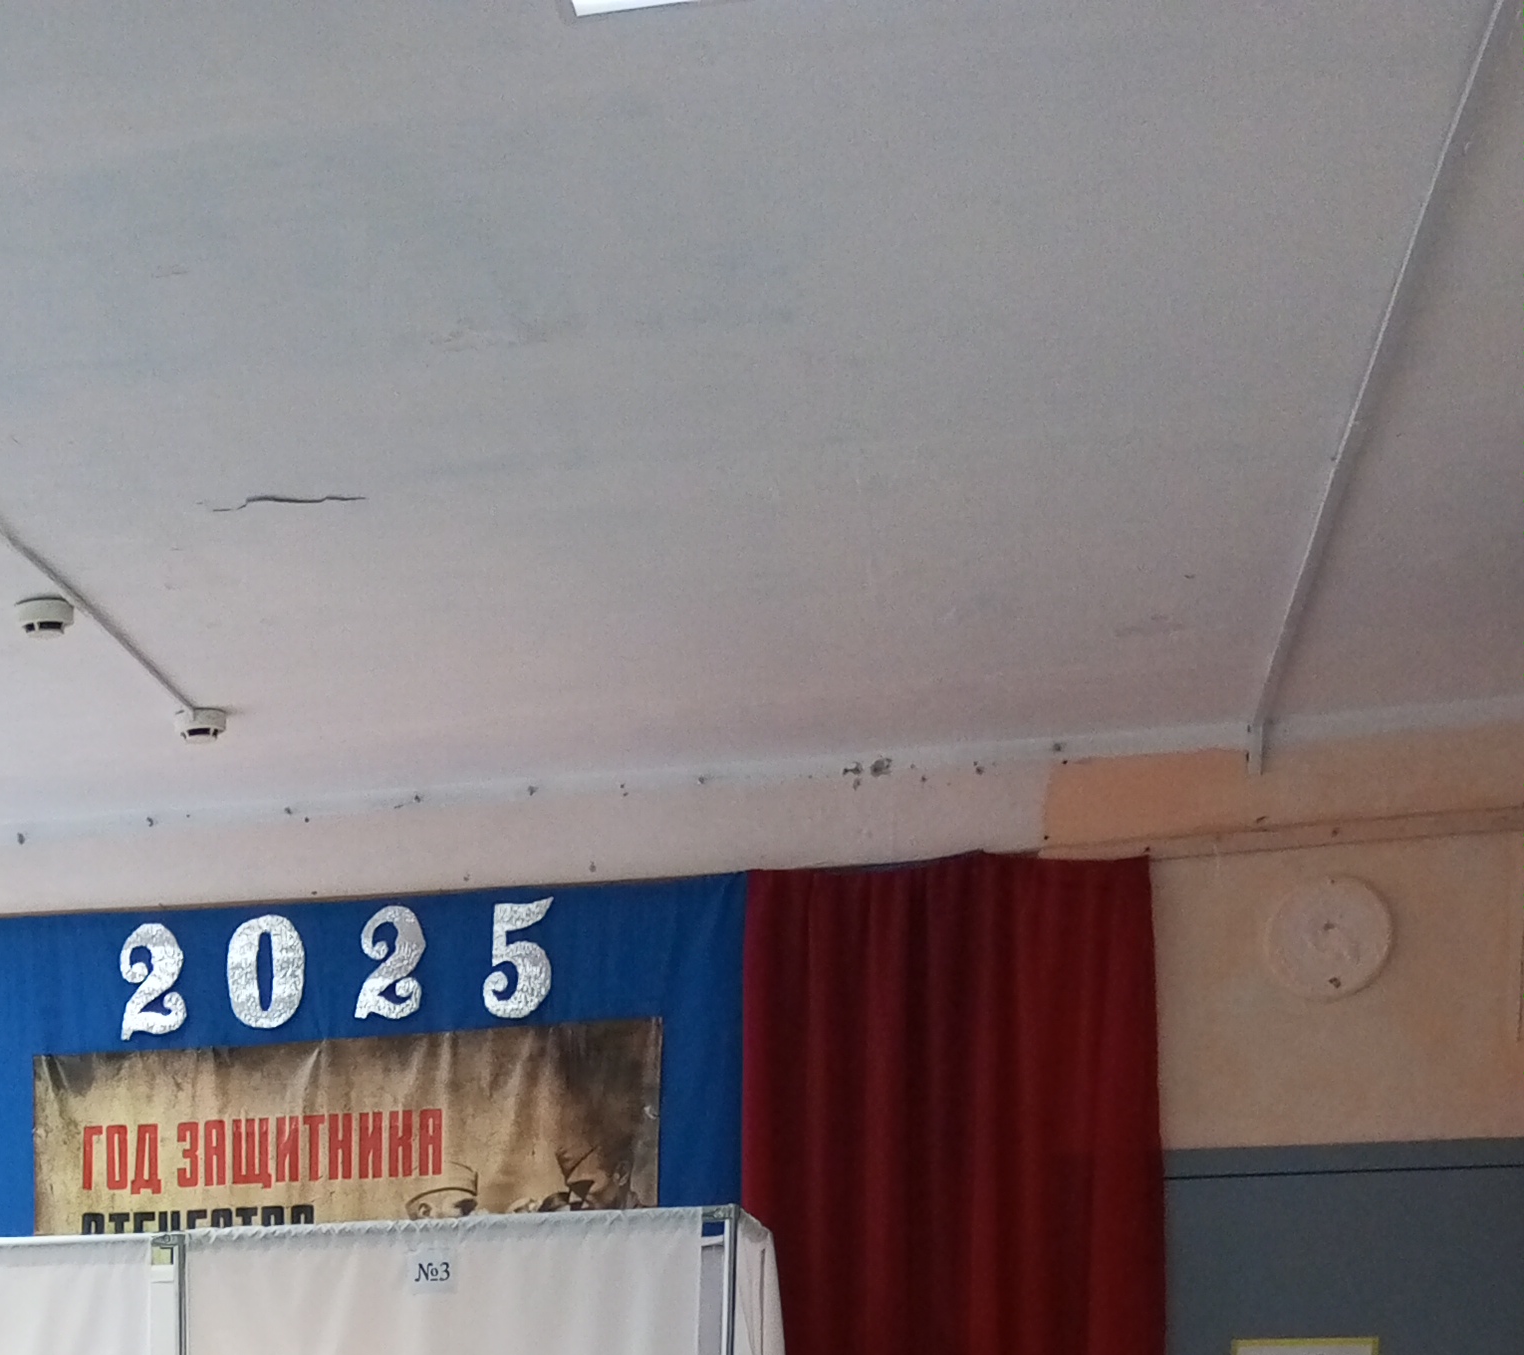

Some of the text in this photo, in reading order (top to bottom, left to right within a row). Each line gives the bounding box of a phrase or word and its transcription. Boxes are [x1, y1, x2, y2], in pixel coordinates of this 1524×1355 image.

[119, 896, 554, 1041] 2025
[81, 1108, 443, 1195] ГОД ЗАЩИТНИКА
[414, 1261, 451, 1282] №3
